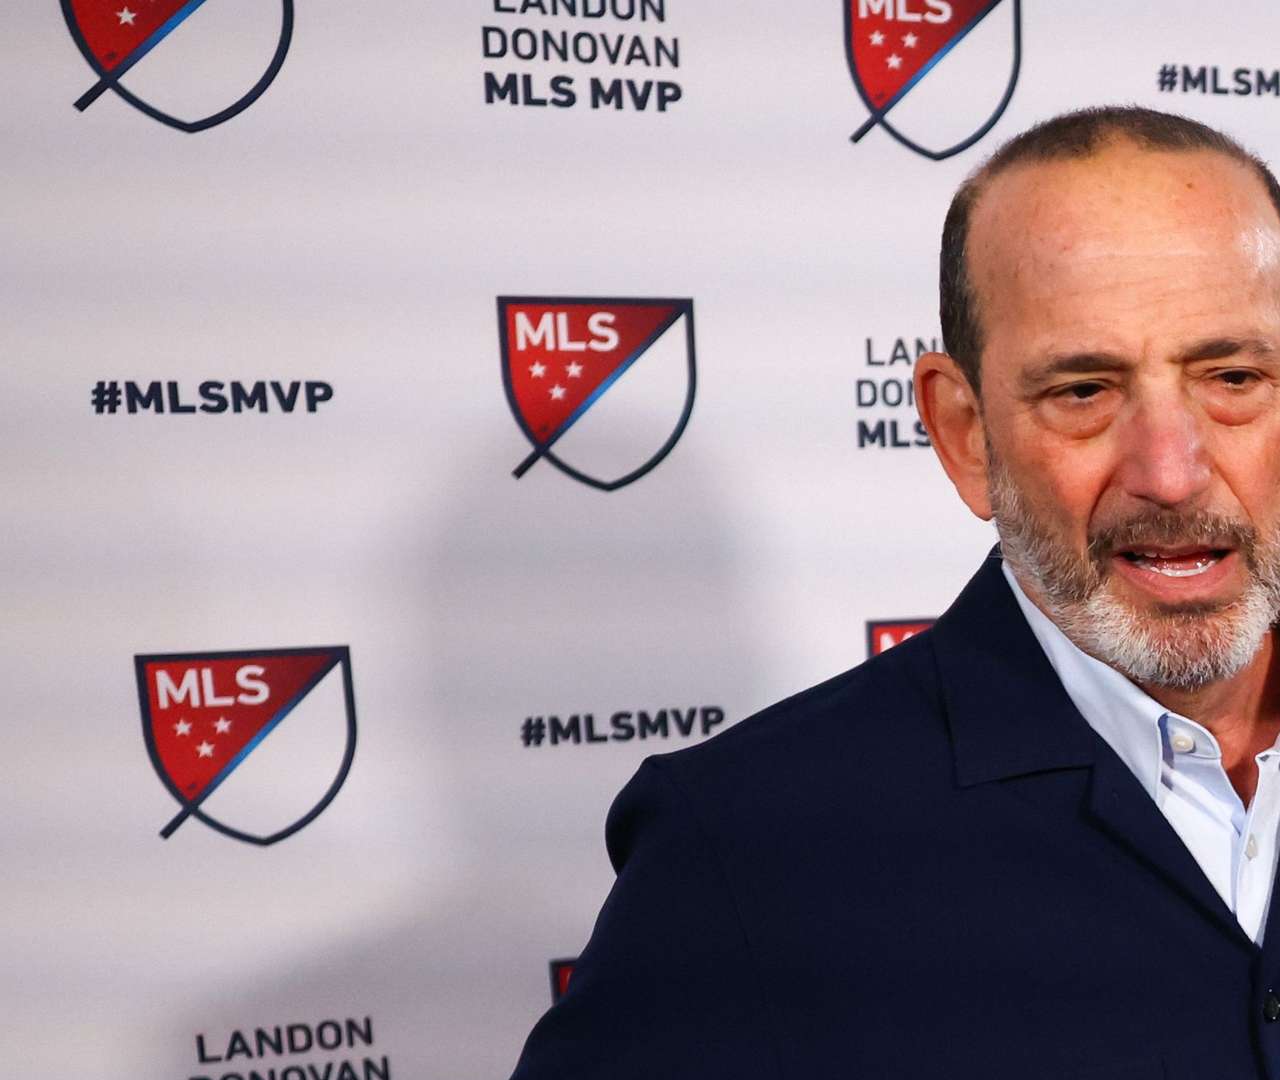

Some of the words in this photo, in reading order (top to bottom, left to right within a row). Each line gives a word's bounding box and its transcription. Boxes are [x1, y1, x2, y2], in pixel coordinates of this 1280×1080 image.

[858, 0, 953, 24] MLS
[482, 26, 680, 68] DONOVAN
[484, 71, 577, 108] MLS
[590, 77, 683, 112] MVP
[515, 312, 620, 352] MLS
[866, 338, 945, 366] LAN
[91, 380, 334, 415] #MLSMVP
[155, 664, 271, 709] MLS
[520, 706, 726, 748] #MLSMVP
[196, 1016, 374, 1064] LANDON
